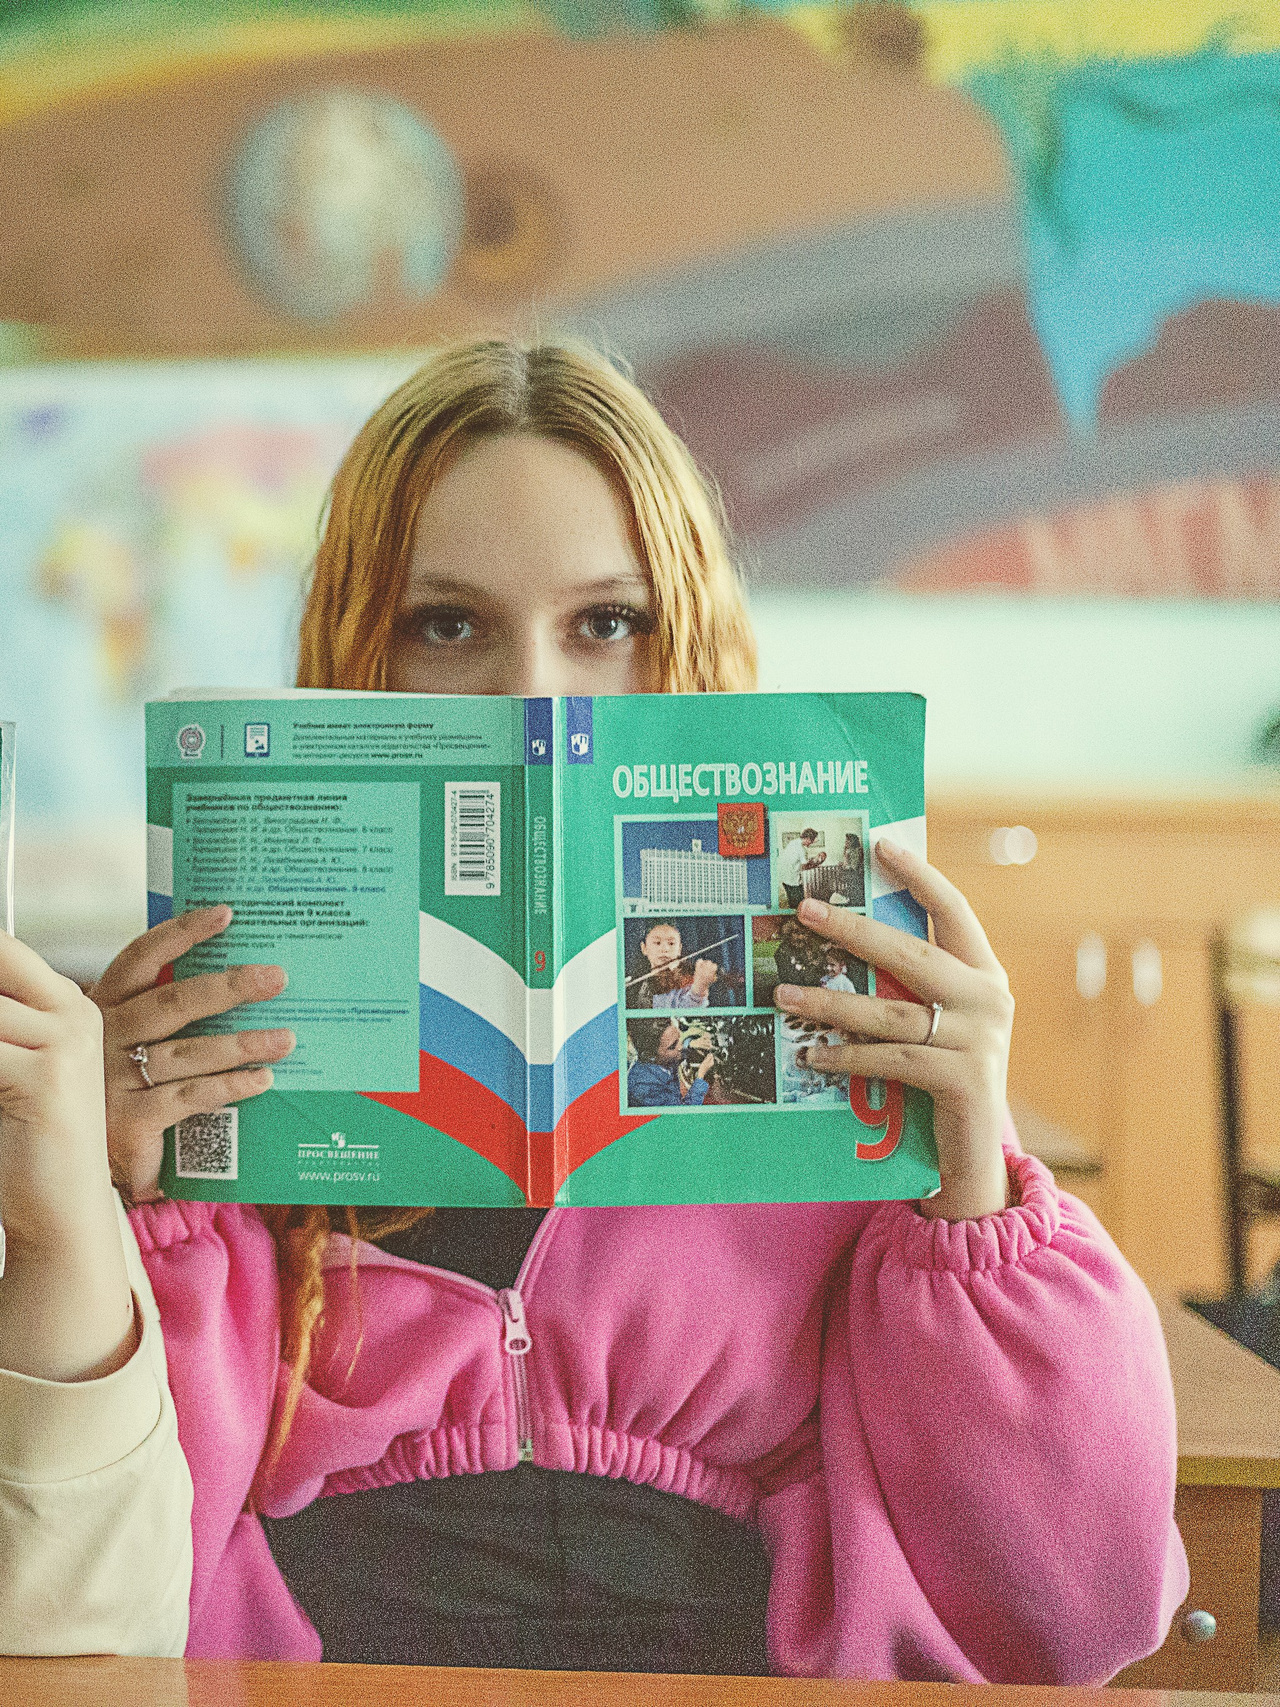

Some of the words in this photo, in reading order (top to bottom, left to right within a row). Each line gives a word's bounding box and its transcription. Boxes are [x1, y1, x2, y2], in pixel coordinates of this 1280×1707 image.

[612, 760, 869, 804] ОБЩЕСТВОЗНАНИЕ
[533, 815, 548, 915] ОБЩЕСТВОЗНАНИЕ
[485, 882, 495, 890] 9
[534, 950, 547, 972] 9
[849, 1073, 904, 1160] 9
[297, 1149, 380, 1160] ПРОСВЕЩЕНИЕ
[297, 1171, 381, 1184] www.prosv.ru
